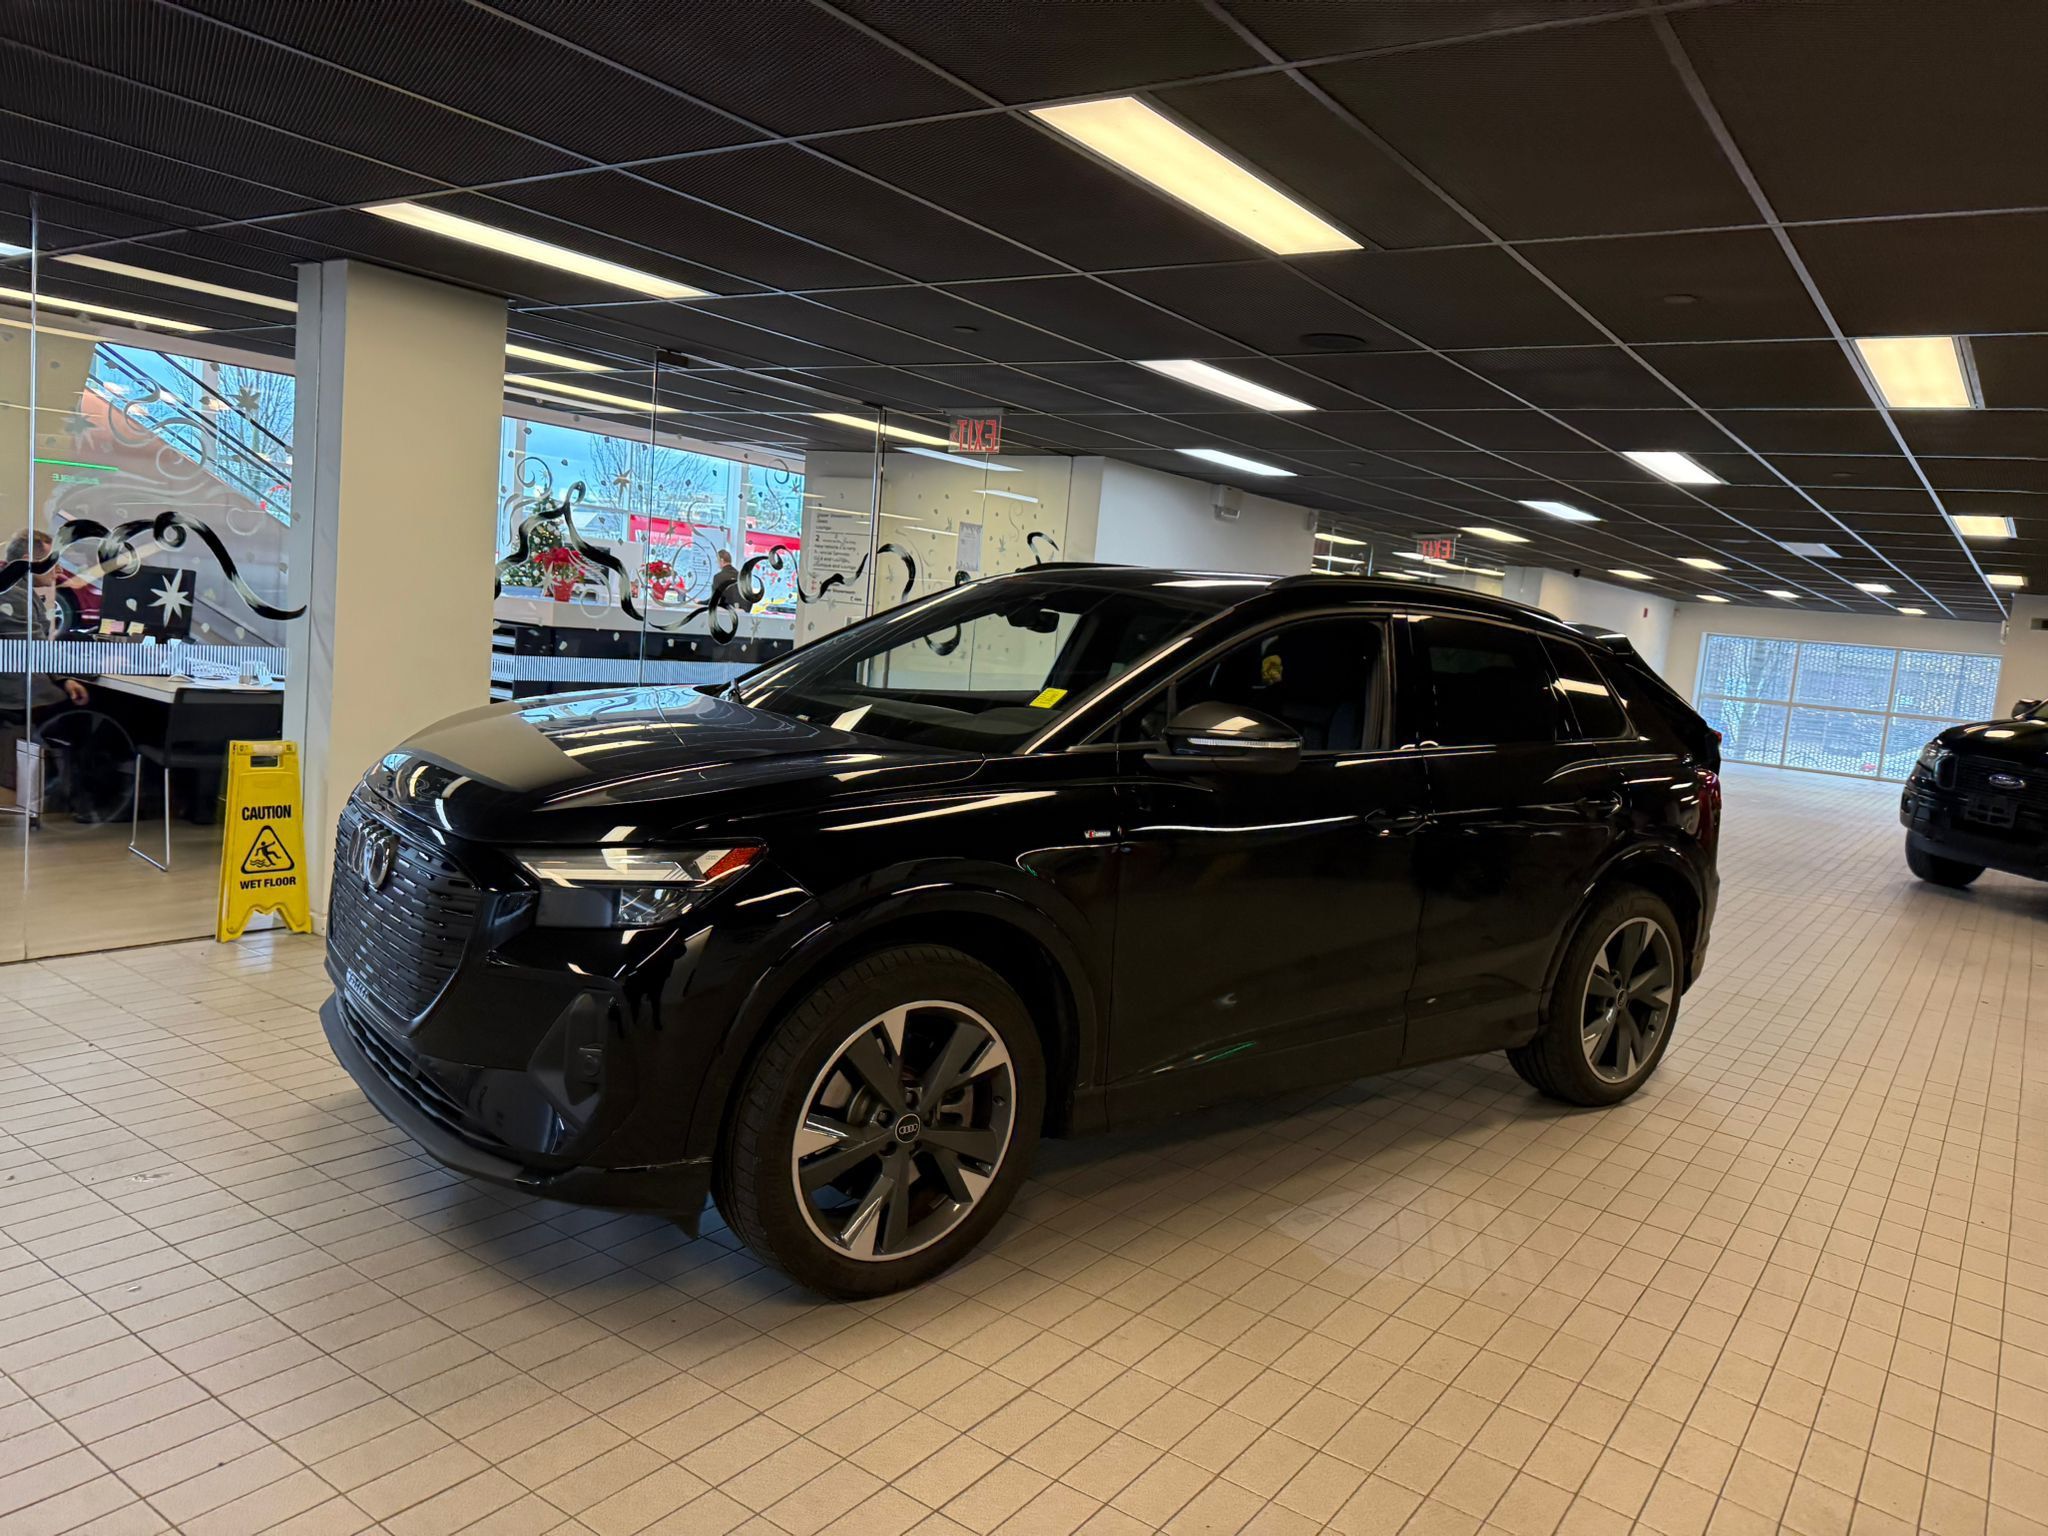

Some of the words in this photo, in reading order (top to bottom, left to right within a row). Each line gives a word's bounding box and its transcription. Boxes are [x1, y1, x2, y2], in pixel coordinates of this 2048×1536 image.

[241, 804, 292, 821] CAUTION
[240, 879, 262, 890] WET
[263, 876, 297, 888] FLOOR
